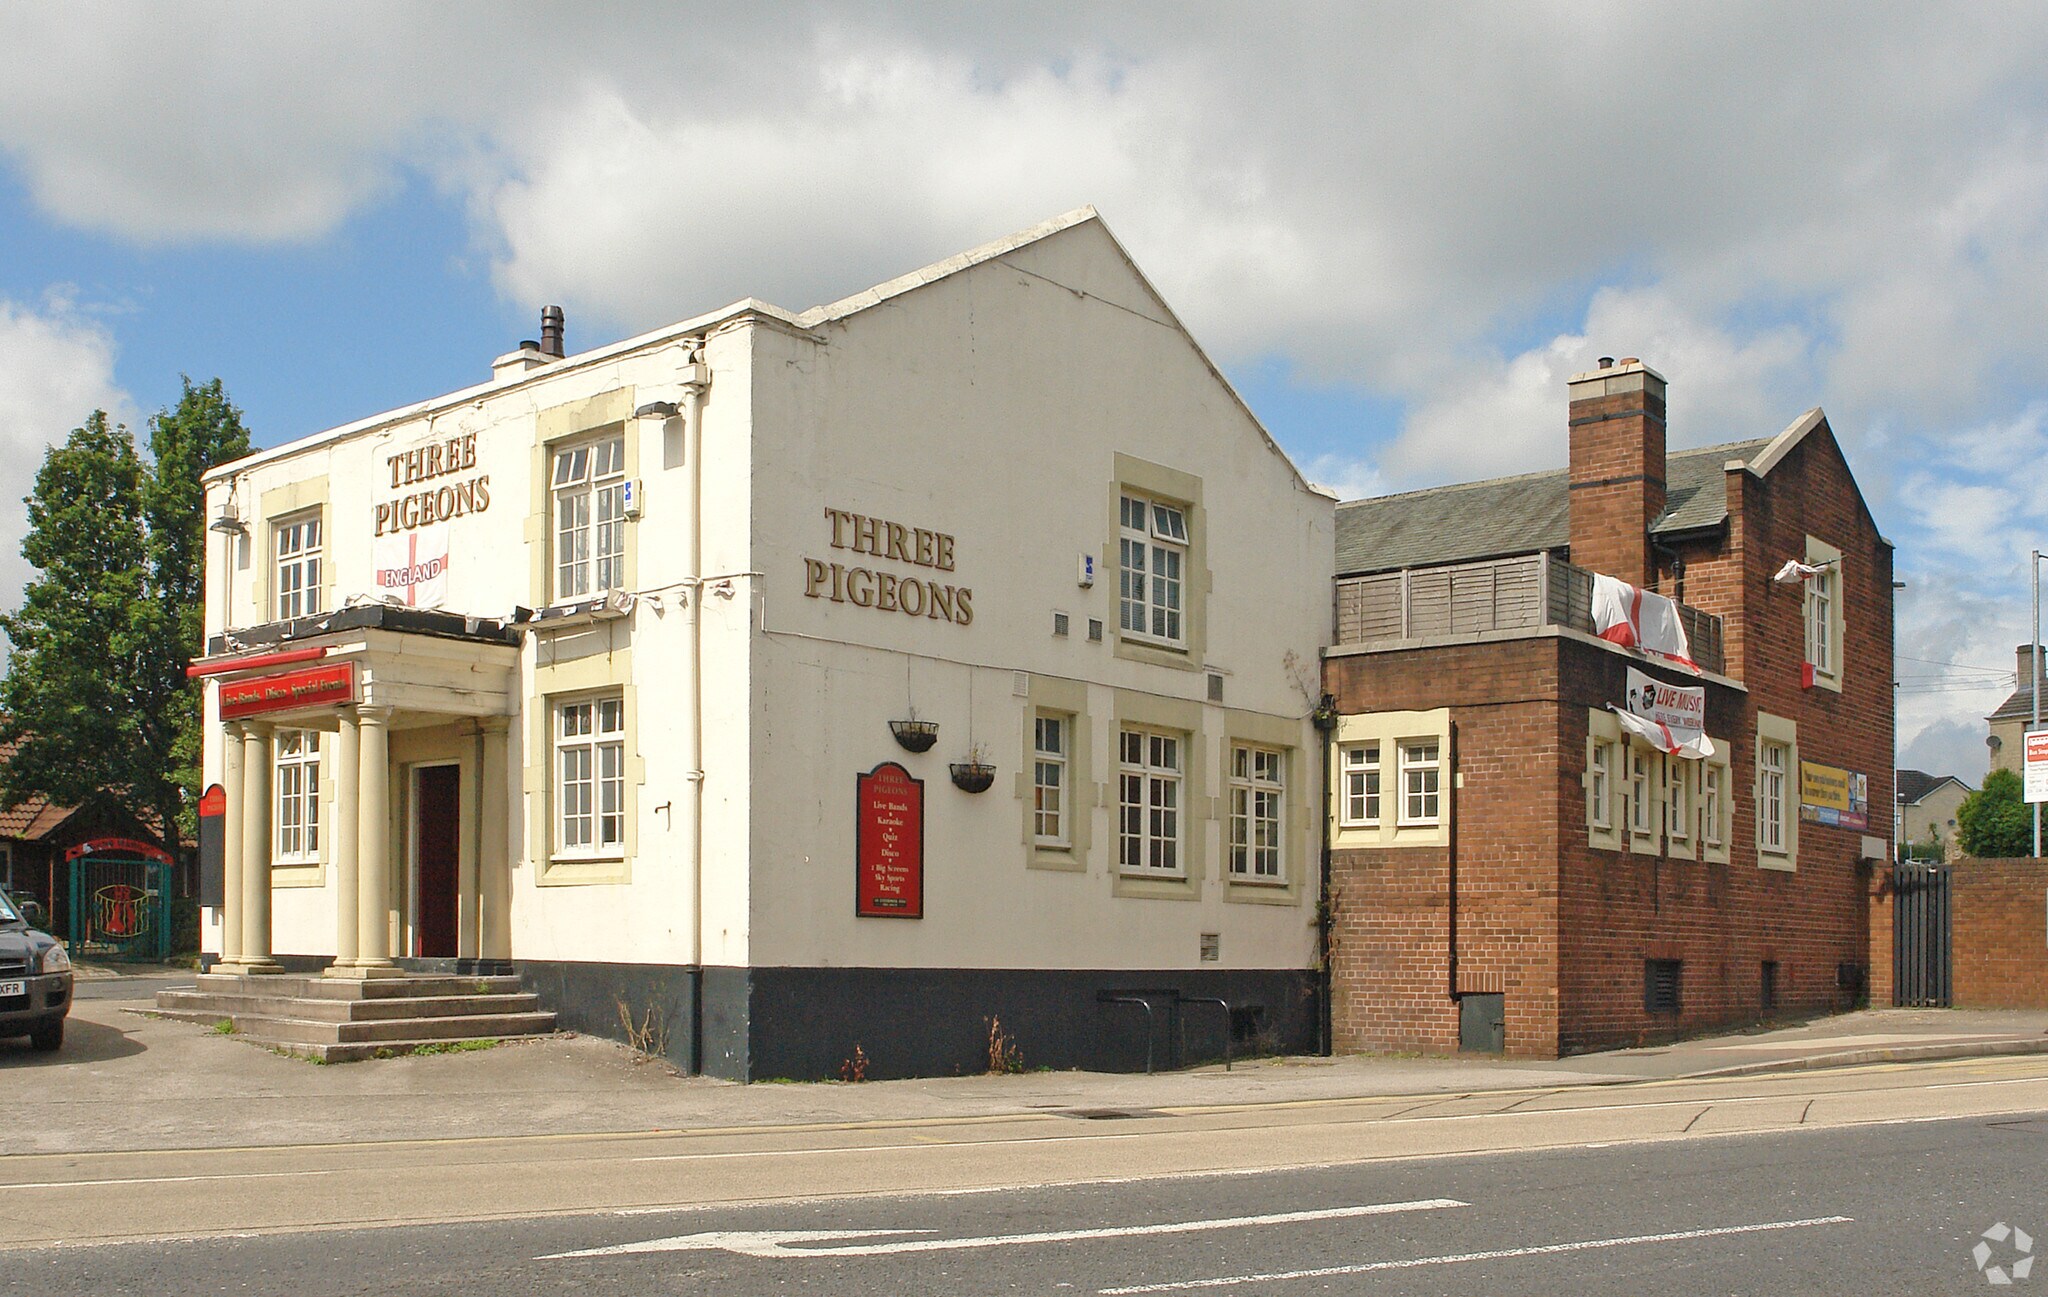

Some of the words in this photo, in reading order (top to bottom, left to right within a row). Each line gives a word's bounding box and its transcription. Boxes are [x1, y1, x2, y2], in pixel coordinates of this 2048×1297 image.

[387, 433, 476, 489] THREE
[375, 474, 490, 537] PIGEONS
[824, 507, 955, 572] THREE
[384, 558, 442, 588] ENGLAND
[804, 557, 974, 625] PIGEONS
[223, 693, 237, 707] Live
[239, 689, 260, 705] Bands
[265, 686, 287, 700] Disco
[291, 680, 318, 700] Special
[320, 679, 346, 692] Events
[1656, 687, 1677, 708] LIVE
[878, 774, 904, 784] THREE
[873, 784, 908, 796] PIGEONS
[873, 800, 887, 810] Live
[888, 802, 908, 812] Bands
[877, 816, 904, 826] Karaoke
[882, 832, 898, 843] Quiz
[881, 848, 900, 857] Disco
[876, 863, 886, 874] Big
[888, 864, 909, 873] Screens
[875, 873, 885, 884] Sky
[887, 874, 905, 884] Sports
[880, 884, 900, 894] Racing
